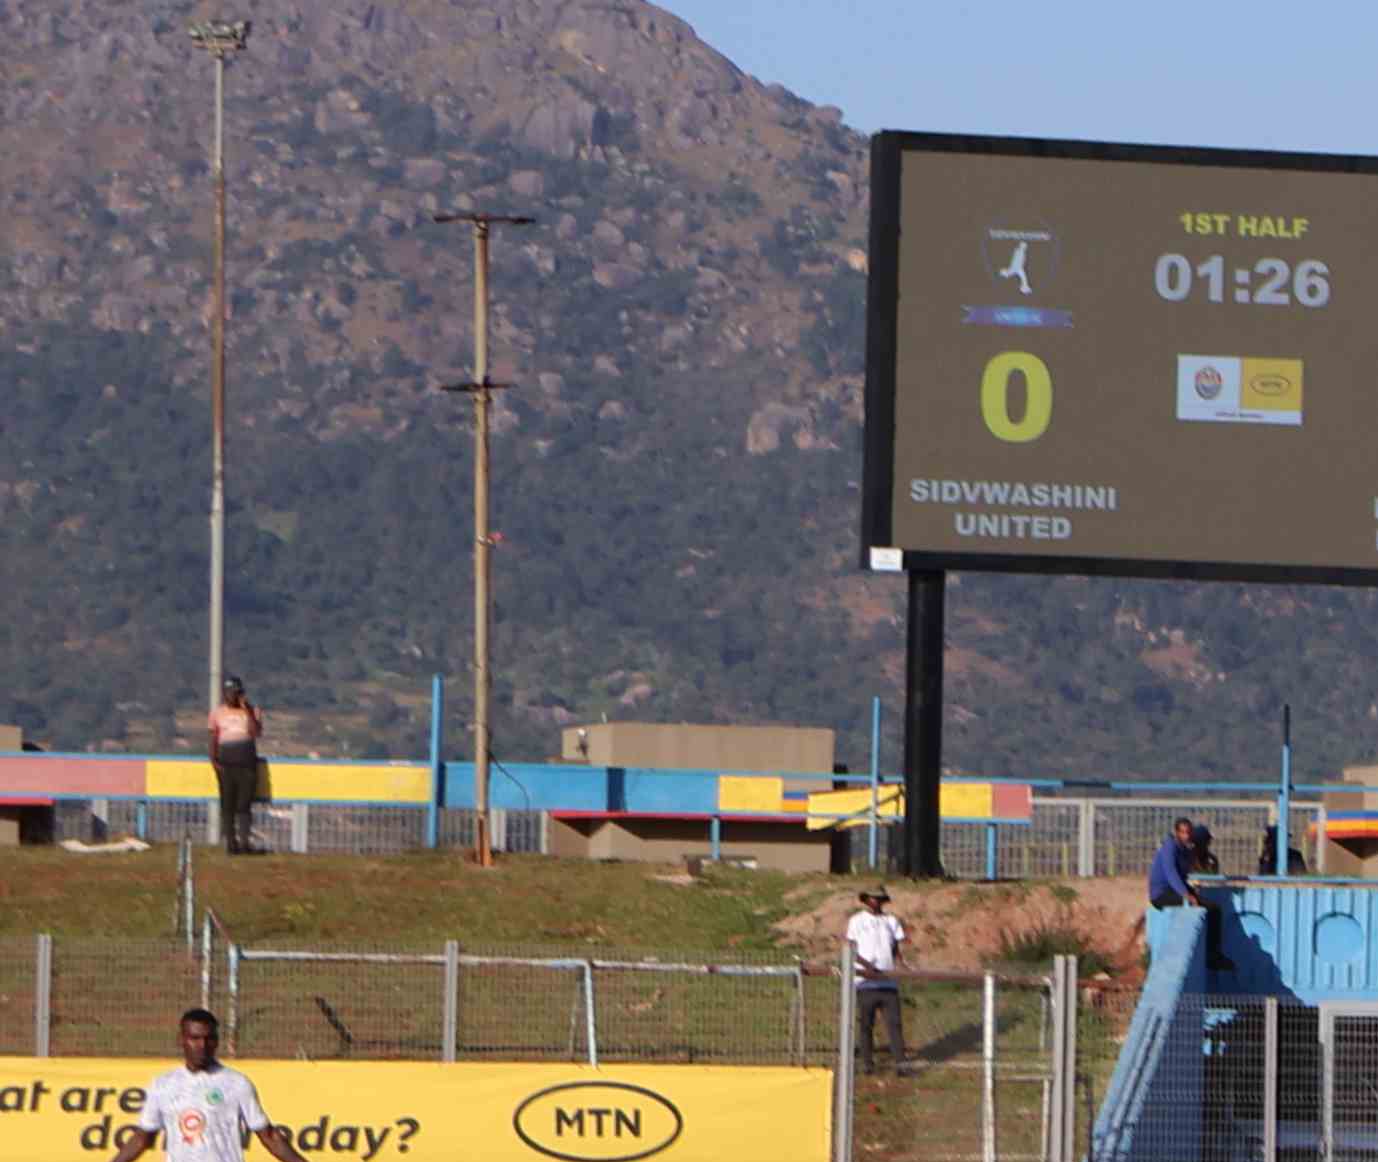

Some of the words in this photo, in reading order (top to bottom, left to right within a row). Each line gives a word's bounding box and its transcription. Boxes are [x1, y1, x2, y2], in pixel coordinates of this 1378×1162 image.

[1181, 211, 1231, 236] 1ST
[1238, 214, 1309, 239] HALF
[1155, 252, 1331, 307] 01:26
[980, 350, 1053, 443] 0
[911, 478, 1117, 510] SIDVWASHINI
[955, 512, 1072, 540] UNITED
[60, 1087, 147, 1113] are
[555, 1107, 641, 1138] MTN
